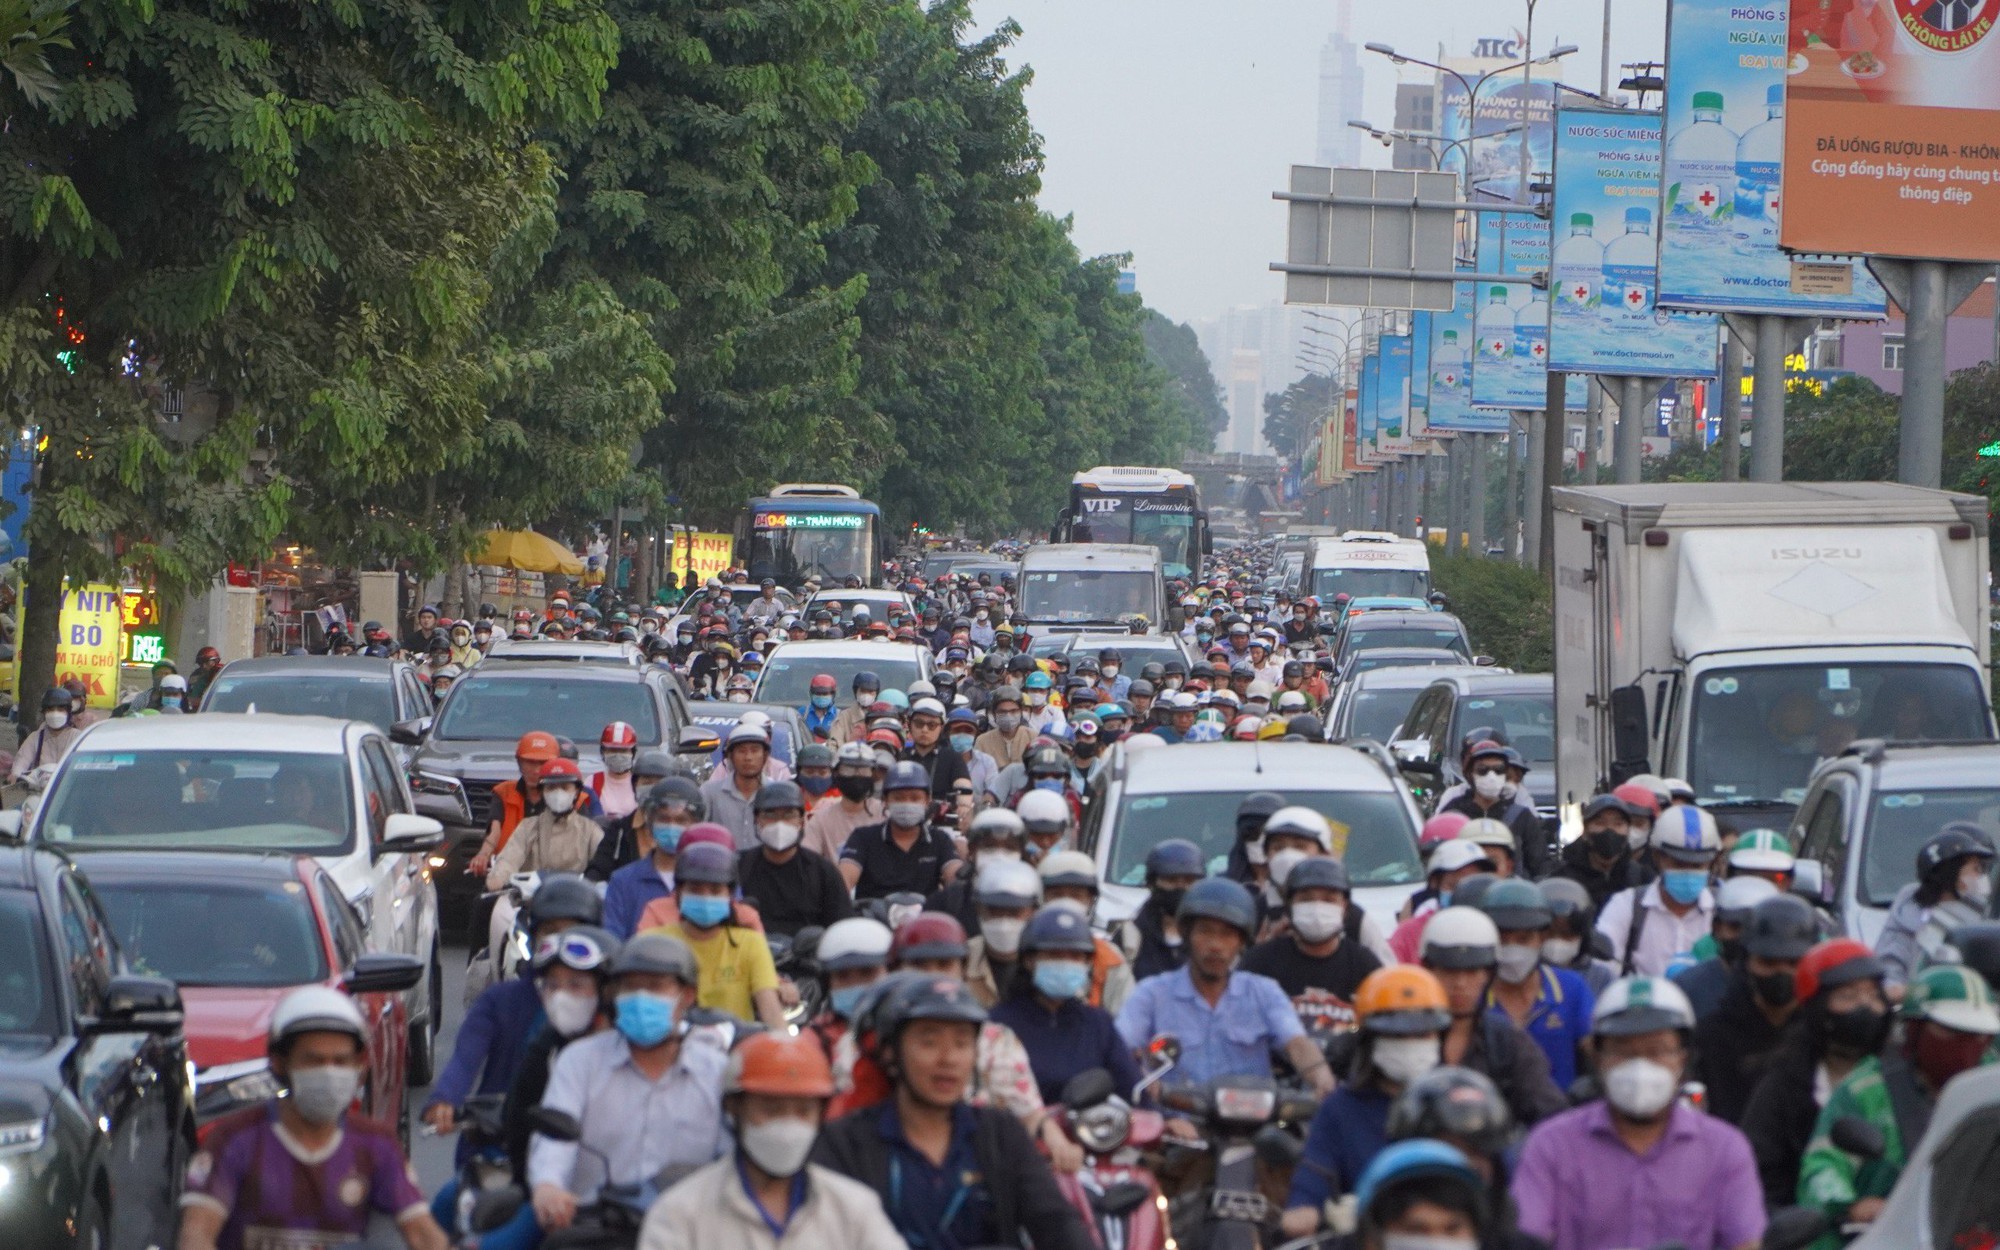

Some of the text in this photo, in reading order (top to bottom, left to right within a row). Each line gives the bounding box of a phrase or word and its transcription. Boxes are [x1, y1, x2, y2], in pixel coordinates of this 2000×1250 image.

[1731, 7, 1775, 21] PHÒNG
[1729, 30, 1785, 44] NGỪA VI
[1903, 12, 1992, 49] KHÔNG LÁI XE
[1568, 126, 1601, 137] NƯỚC
[1603, 127, 1624, 138] SÚC
[1816, 135, 1836, 151] ĐÃ
[1840, 136, 1880, 153] UỐNG
[1884, 141, 1923, 158] RƯỢU
[1926, 143, 1949, 157] BIA
[1960, 144, 2000, 160] KHÔN
[1811, 159, 1846, 177] Cộng
[1850, 159, 1884, 179] đồng
[1886, 162, 1911, 180] hãy
[1914, 164, 1946, 182] cùng
[1950, 165, 1990, 184] chung
[1899, 184, 1973, 205] thông điệp
[1722, 276, 1791, 288] www.doctor
[1592, 349, 1675, 359] www.doctormuoi.vn
[1082, 498, 1193, 513] VIP Limousine
[676, 535, 728, 552] BÁNH
[1770, 548, 1862, 560] ISUZU
[77, 590, 118, 617] NỊT
[71, 620, 102, 646] BÒ
[71, 653, 87, 668] TẠI
[692, 716, 740, 726] HUNT
